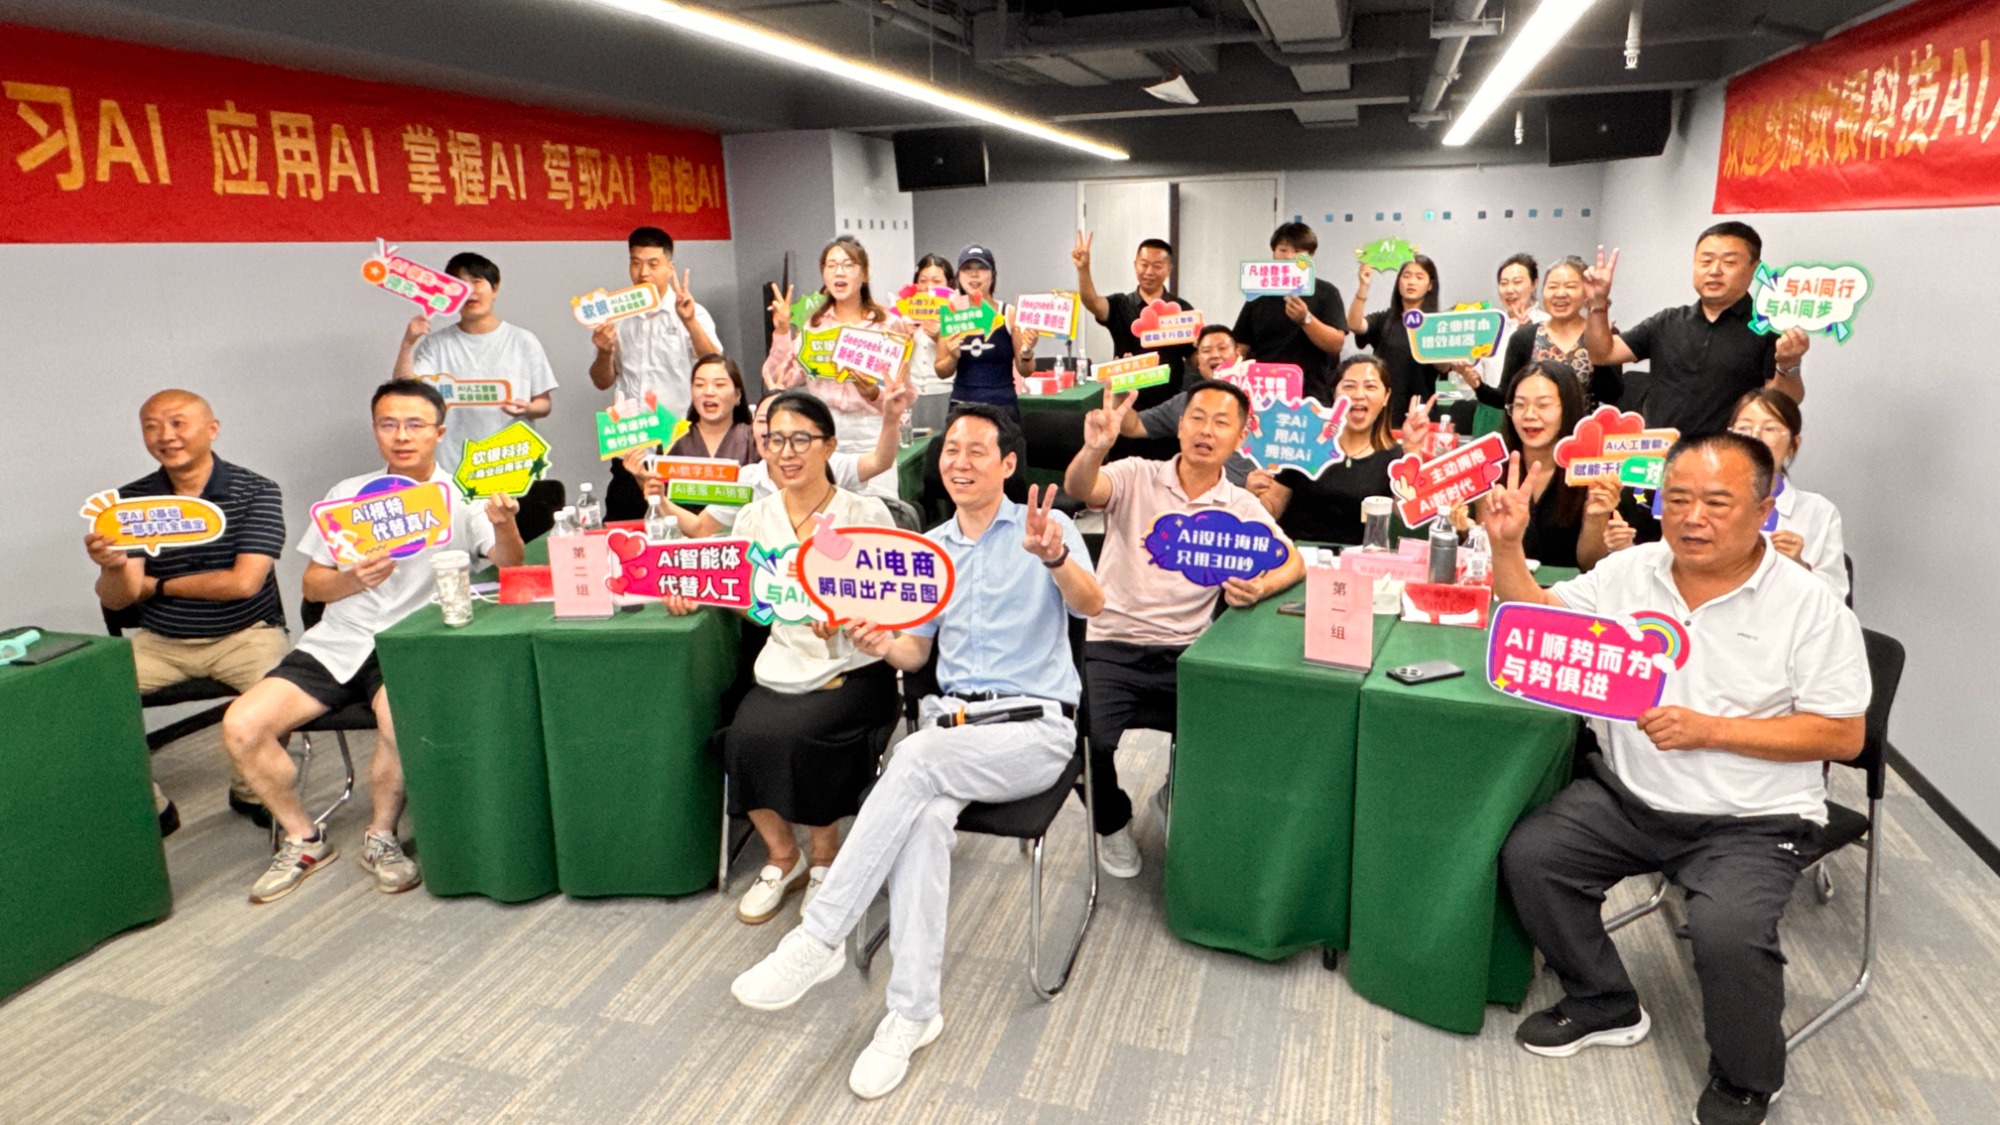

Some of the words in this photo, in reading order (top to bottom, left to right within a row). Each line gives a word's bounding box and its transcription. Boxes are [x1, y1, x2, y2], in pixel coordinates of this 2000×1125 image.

[2, 81, 172, 191] 习AI
[206, 100, 380, 200] 应用AI
[403, 125, 527, 205] 掌握AI
[542, 140, 636, 210] 驾驭AI
[647, 152, 721, 213] 拥抱AI
[1784, 278, 1856, 299] 与Ai同行
[582, 299, 609, 319] 软银
[1406, 314, 1420, 325] Ai
[1765, 298, 1833, 318] 与Ai同步
[1437, 318, 1490, 334] 企业降本
[842, 333, 884, 353] deepseek
[1422, 333, 1475, 348] 增效利器
[1276, 413, 1307, 428] 学Ai
[1274, 429, 1305, 443] 用Ai
[472, 441, 531, 467] 软银科技
[1265, 444, 1312, 462] 拥抱Ai
[1430, 448, 1487, 485] 主动拥抱
[1420, 477, 1476, 514] Ai新时代
[351, 497, 405, 525] Ai模特
[372, 510, 441, 542] 代替真人
[1177, 529, 1270, 552] Ai设计海报
[656, 544, 742, 571] Ai智能体
[855, 547, 936, 579] Ai电商
[1176, 551, 1254, 572] 只用30秒
[572, 546, 590, 597] 第二组
[658, 575, 742, 602] 代替人工
[818, 576, 939, 604] 瞬间出产品图
[1330, 581, 1348, 641] 第一组
[1540, 632, 1652, 681] 顺势而为
[1501, 655, 1610, 702] 与势俱进
